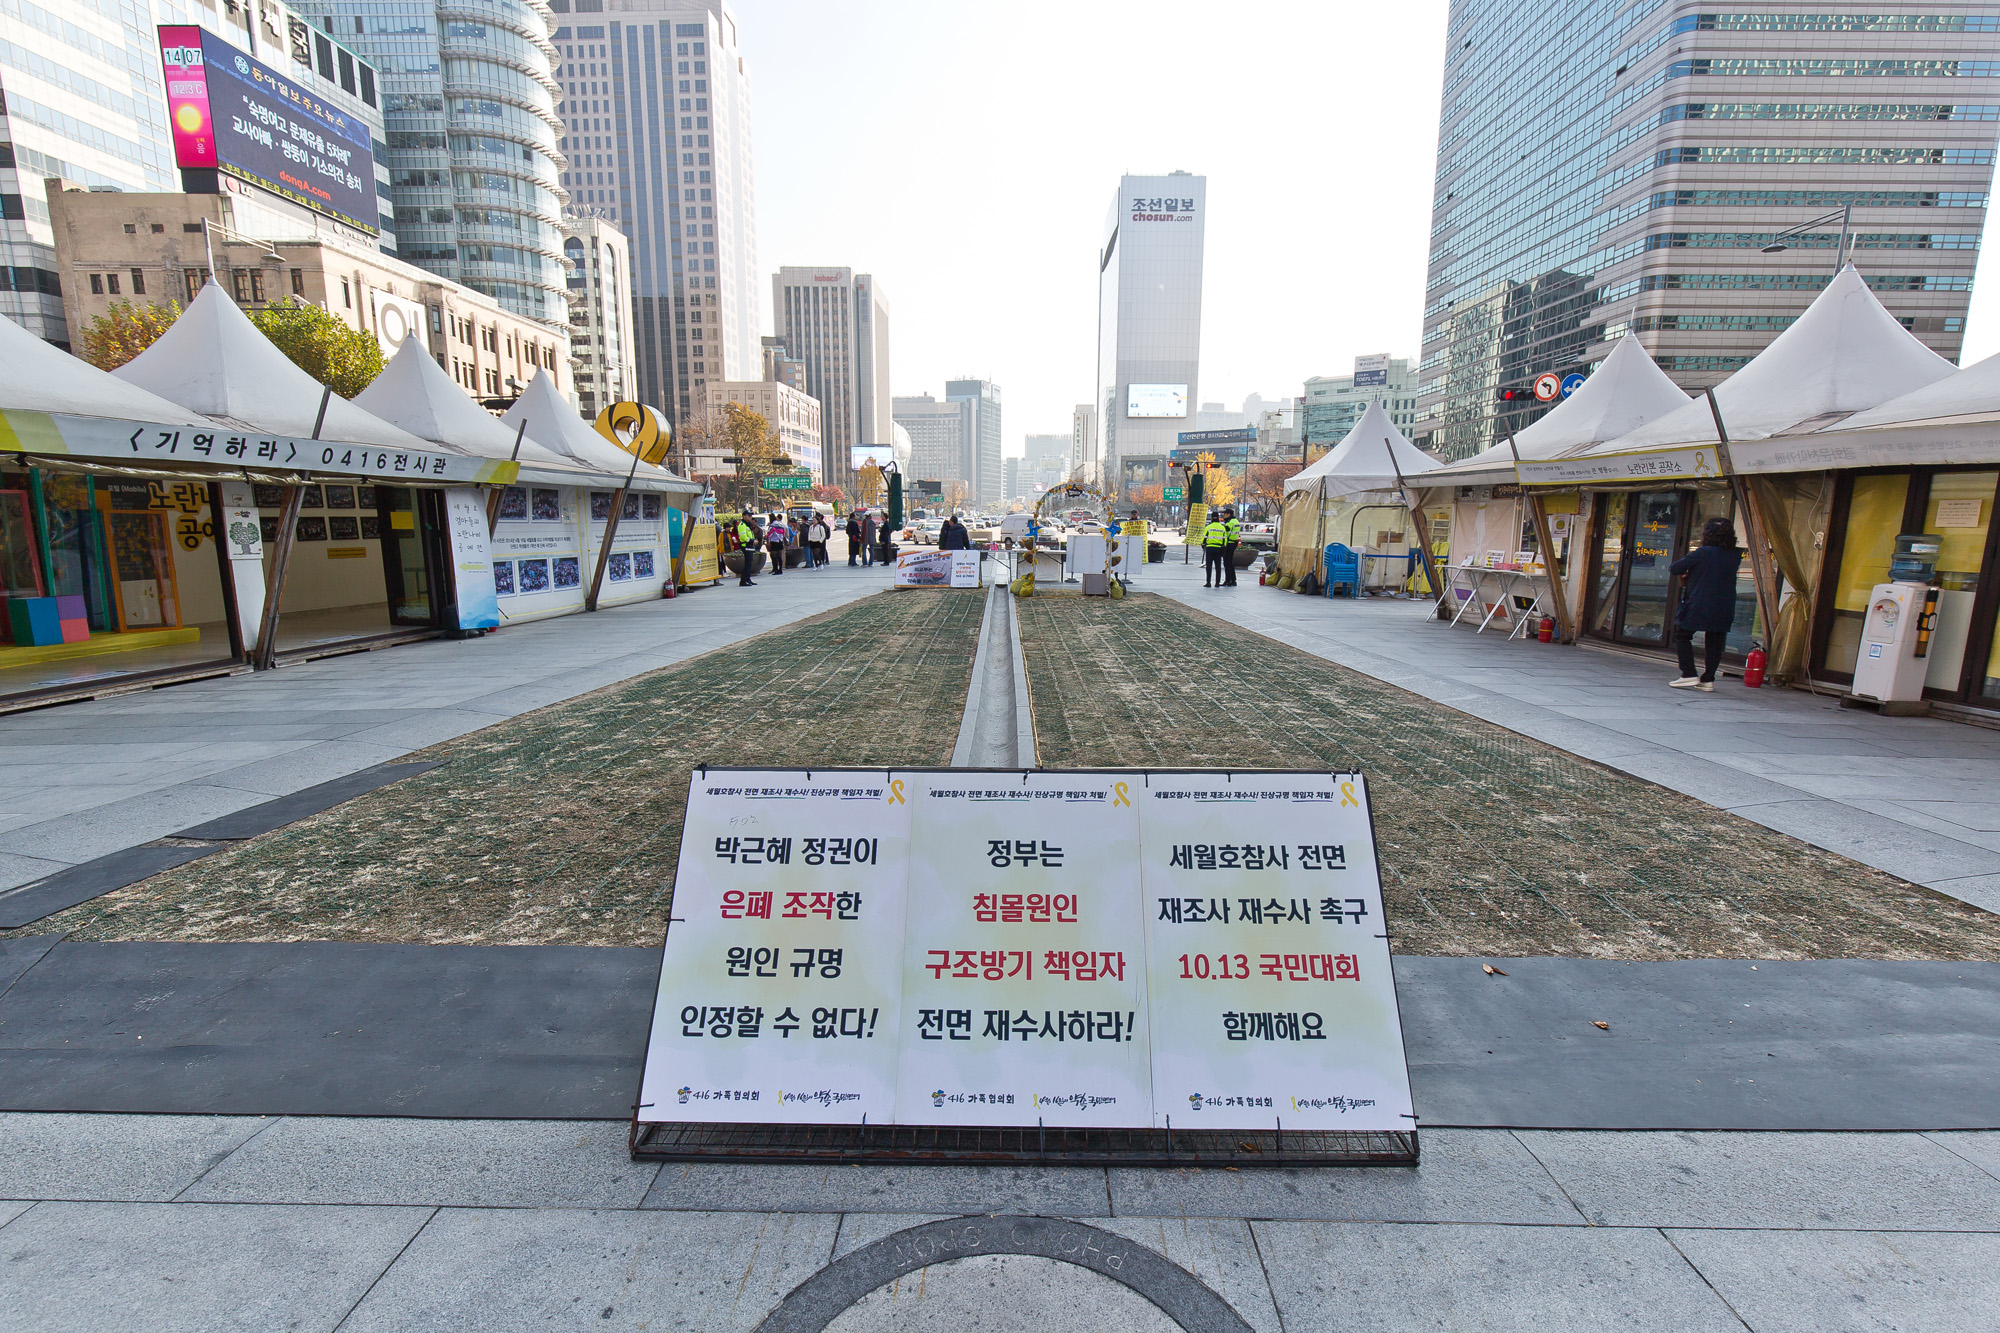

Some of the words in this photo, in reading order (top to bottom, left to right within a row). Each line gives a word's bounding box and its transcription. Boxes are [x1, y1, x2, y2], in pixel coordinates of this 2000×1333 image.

[279, 170, 332, 200] dongA.com
[310, 154, 344, 184] 기소의견
[346, 170, 363, 194] 송치
[239, 183, 254, 198] LG
[1130, 198, 1196, 212] 조선일보
[1132, 212, 1193, 222] chosun.com
[321, 446, 446, 474] 0416전시관
[1627, 462, 1656, 474] 노란리본
[1658, 460, 1682, 474] 공작소
[706, 788, 742, 796] 세월호참사
[744, 788, 760, 796] 전면
[760, 788, 783, 796] 재조사
[784, 788, 810, 796] 재수사!
[810, 788, 839, 796] 진상규명
[840, 788, 863, 797] 책임자
[864, 788, 883, 797] 처벌!
[929, 790, 966, 798] 세월호참사
[967, 790, 982, 798] 전면
[984, 790, 1006, 798] 재조사
[1008, 790, 1034, 798] 재수사!
[1034, 790, 1064, 798] 진상규명
[1065, 790, 1088, 799] 책임자
[1088, 791, 1108, 799] 처벌!
[1154, 791, 1192, 799] 세월호참사
[1192, 791, 1208, 799] 전면
[1210, 791, 1232, 799] 재조사
[1234, 791, 1259, 799] 재수사!
[1260, 791, 1290, 799] 진상규명
[714, 836, 792, 865] 박근혜
[801, 838, 878, 866] 정권이
[986, 840, 1064, 868] 정부는
[1169, 844, 1290, 870] 세월호참사
[1298, 844, 1346, 870] 전면
[720, 890, 773, 920] 은폐
[782, 891, 862, 920] 조작한
[972, 892, 1078, 922] 침몰원인
[1158, 898, 1230, 924] 재조사
[1238, 898, 1311, 924] 재수사
[1320, 898, 1368, 924] 촉구
[726, 946, 779, 978] 원인
[790, 948, 843, 978] 규명
[926, 950, 1032, 980] 구조방기
[1044, 950, 1126, 982] 책임자
[1178, 954, 1250, 980] 10.13
[1258, 953, 1360, 982] 국민대회
[680, 1005, 764, 1038] 인정할
[773, 1006, 800, 1038] 수
[811, 1007, 880, 1039] 없다!
[917, 1008, 972, 1040] 전면
[982, 1010, 1134, 1042] 재수사하라!
[1222, 1011, 1327, 1041] 함께해요
[692, 1090, 710, 1100] 416
[712, 1090, 731, 1100] 가족
[734, 1090, 760, 1101] 협의회
[948, 1092, 965, 1103] 416
[968, 1094, 986, 1104] 가족
[988, 1094, 1015, 1104] 협의회
[1206, 1096, 1223, 1106] 416
[1226, 1097, 1244, 1107] 가족
[1246, 1097, 1273, 1108] 협의회
